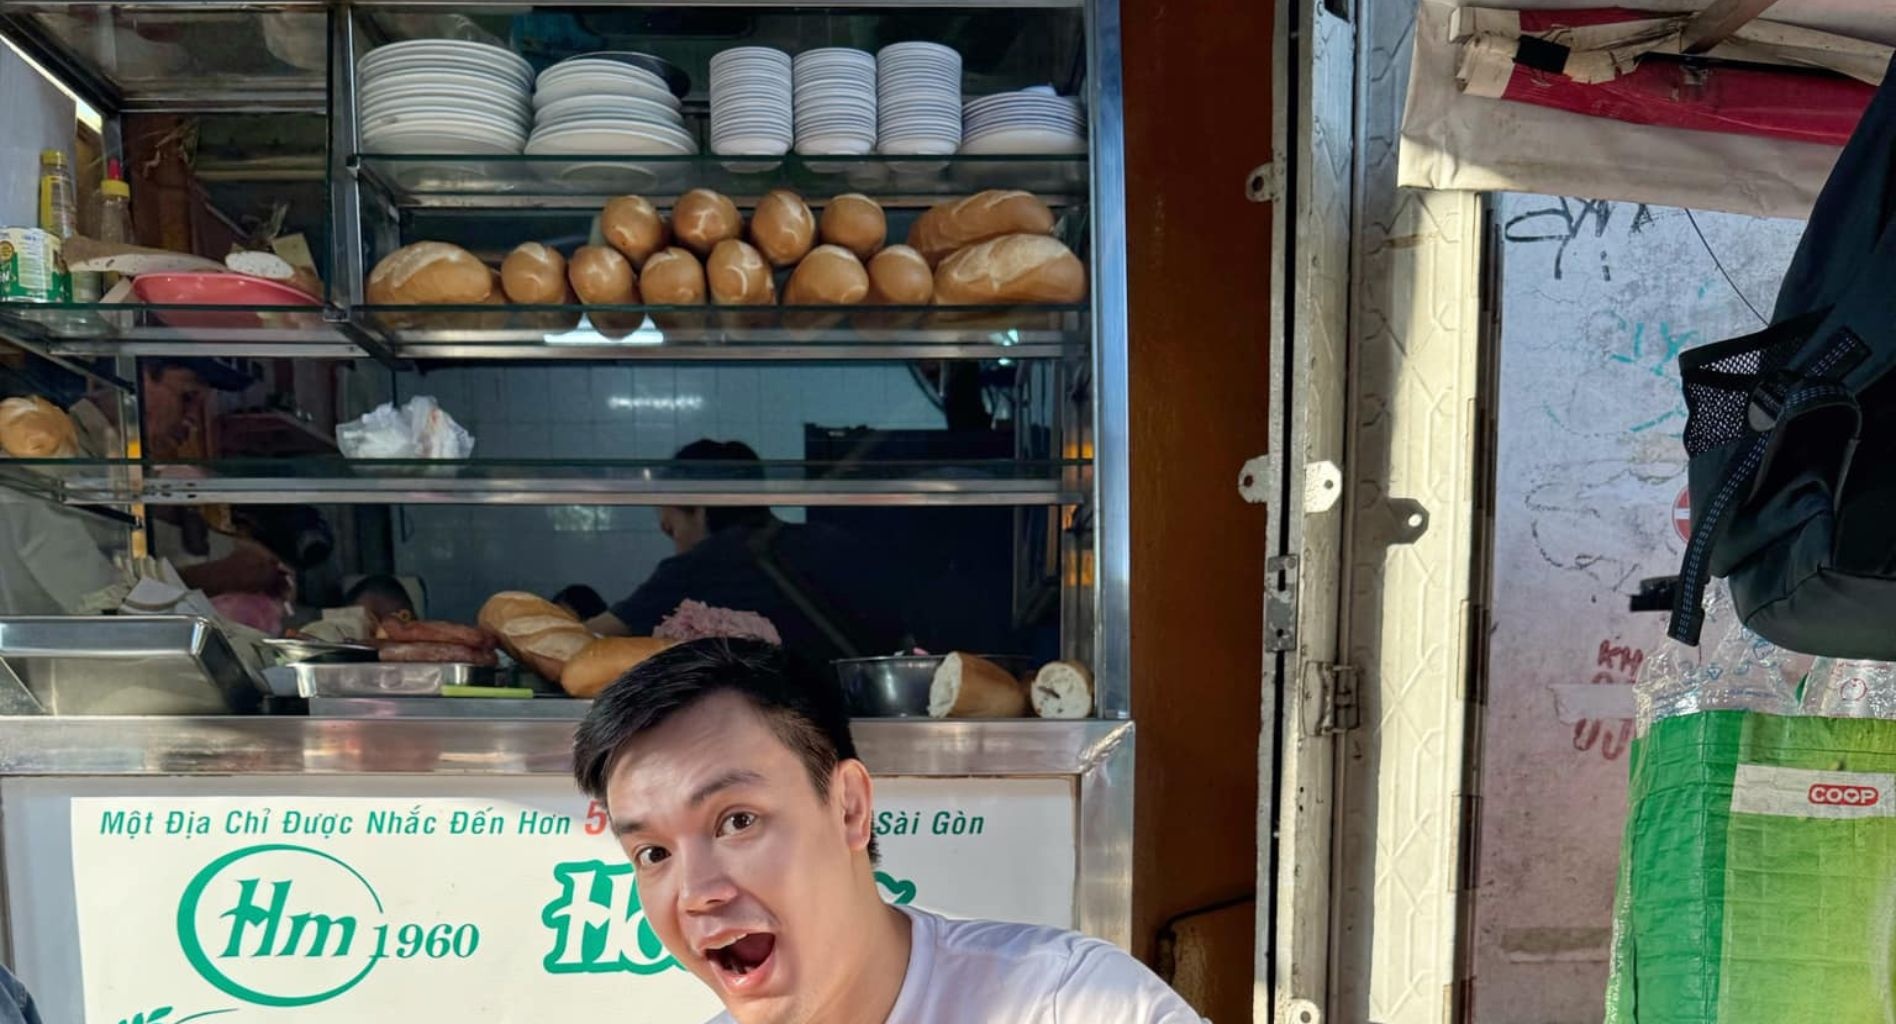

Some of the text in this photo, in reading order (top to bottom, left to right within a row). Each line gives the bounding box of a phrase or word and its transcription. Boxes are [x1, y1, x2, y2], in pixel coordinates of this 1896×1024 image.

[100, 800, 985, 839] Một Địa Chỉ Được Nhắc Đến Hơn 5 Sài Gòn
[1811, 786, 1876, 803] COOP
[217, 877, 481, 959] Hm 1960
[542, 859, 688, 975] Ho
